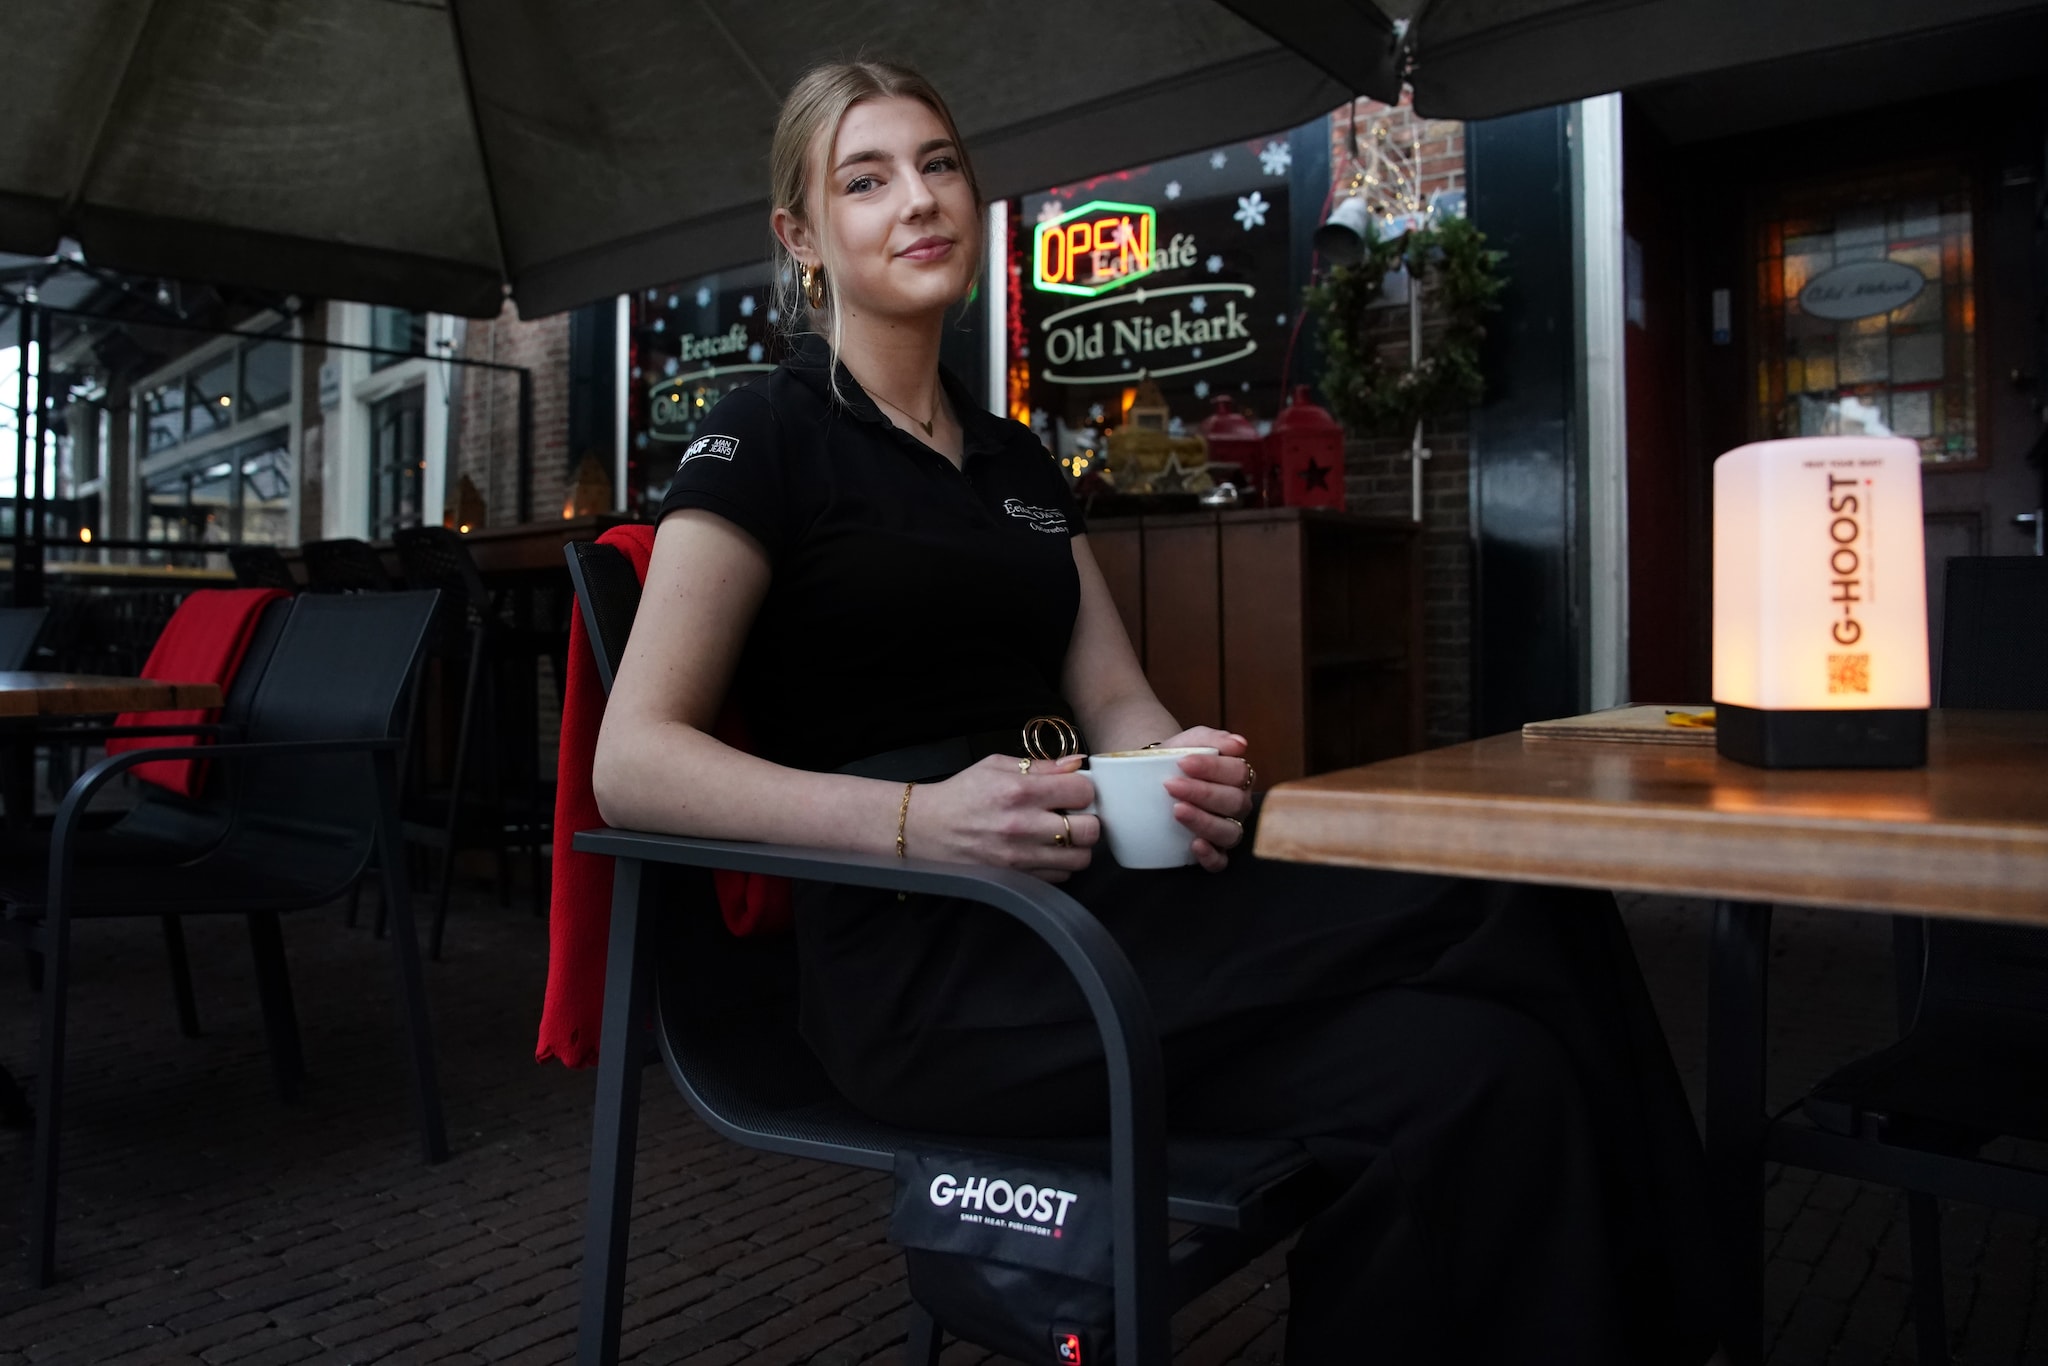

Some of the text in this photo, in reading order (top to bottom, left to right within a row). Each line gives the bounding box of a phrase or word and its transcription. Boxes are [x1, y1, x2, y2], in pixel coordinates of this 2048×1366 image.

[1042, 214, 1149, 283] OPEN
[680, 323, 749, 361] Eetcafé
[1045, 301, 1251, 366] Old Niekark
[651, 392, 689, 425] Old
[708, 444, 733, 456] JEANS
[714, 438, 732, 448] MAN
[1827, 473, 1863, 646] G-HOOST
[930, 1174, 1077, 1226] G-HOOST
[960, 1213, 982, 1223] SMART
